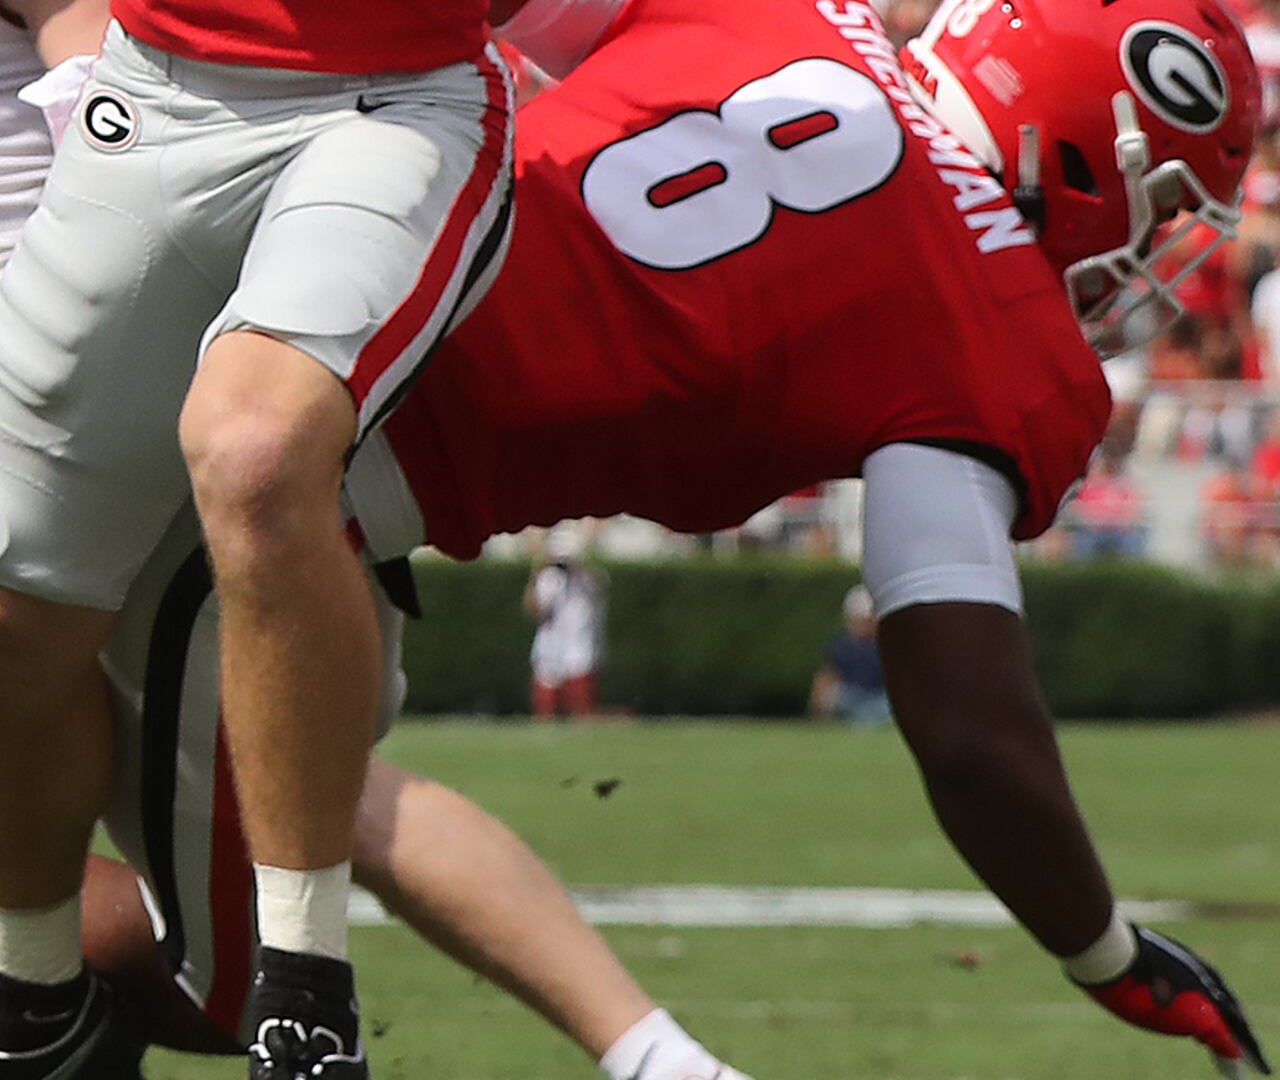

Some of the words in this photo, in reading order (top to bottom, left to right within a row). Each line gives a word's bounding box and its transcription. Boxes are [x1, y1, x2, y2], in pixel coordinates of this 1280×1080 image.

[83, 93, 136, 149] G
[1126, 26, 1225, 127] G
[581, 57, 905, 271] 8
